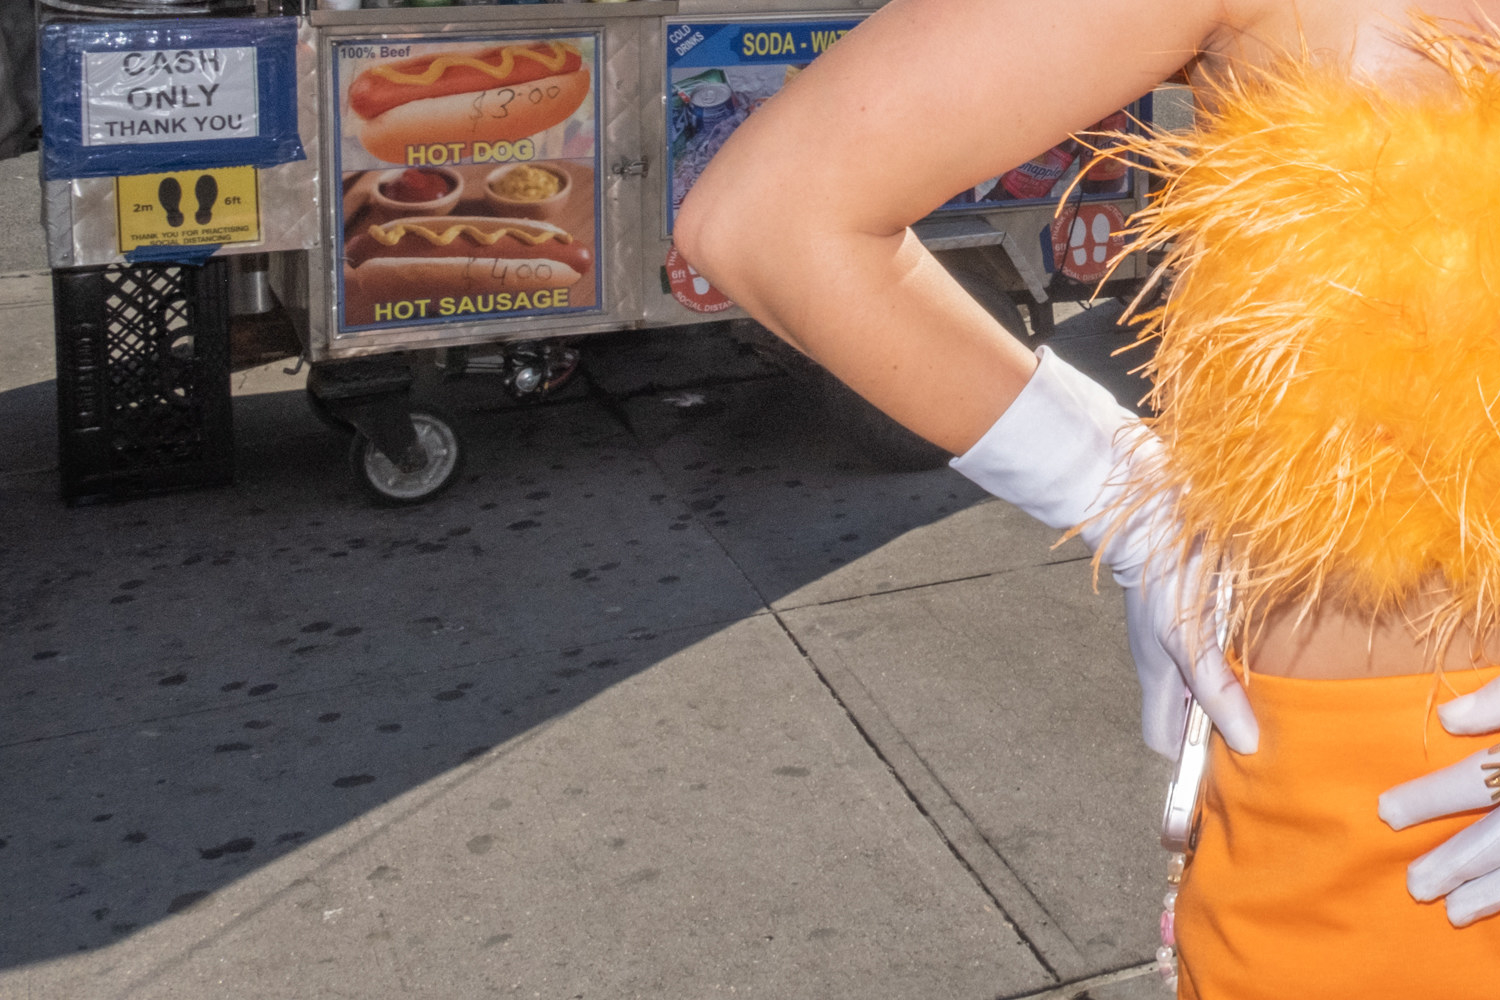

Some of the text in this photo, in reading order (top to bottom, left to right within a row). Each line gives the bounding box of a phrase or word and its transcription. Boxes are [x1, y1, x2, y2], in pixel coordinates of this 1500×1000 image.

[668, 24, 692, 45] COLD
[675, 31, 705, 57] DRINKS
[742, 31, 797, 56] SODA
[122, 49, 220, 77] CASH
[340, 45, 411, 60] 100% Beef
[127, 83, 220, 111] ONLY
[105, 113, 243, 137] THANK YOU
[407, 138, 536, 167] HOT DOG
[133, 195, 242, 214] 2m 6ft
[131, 231, 160, 241] THANK
[162, 230, 180, 239] YOU
[181, 229, 199, 237] FOR
[183, 234, 233, 244] DISTANCING
[668, 246, 678, 267] THA
[671, 269, 686, 279] 6ft
[374, 288, 570, 322] HOT SAUSAGE
[676, 290, 703, 311] SOCIAL
